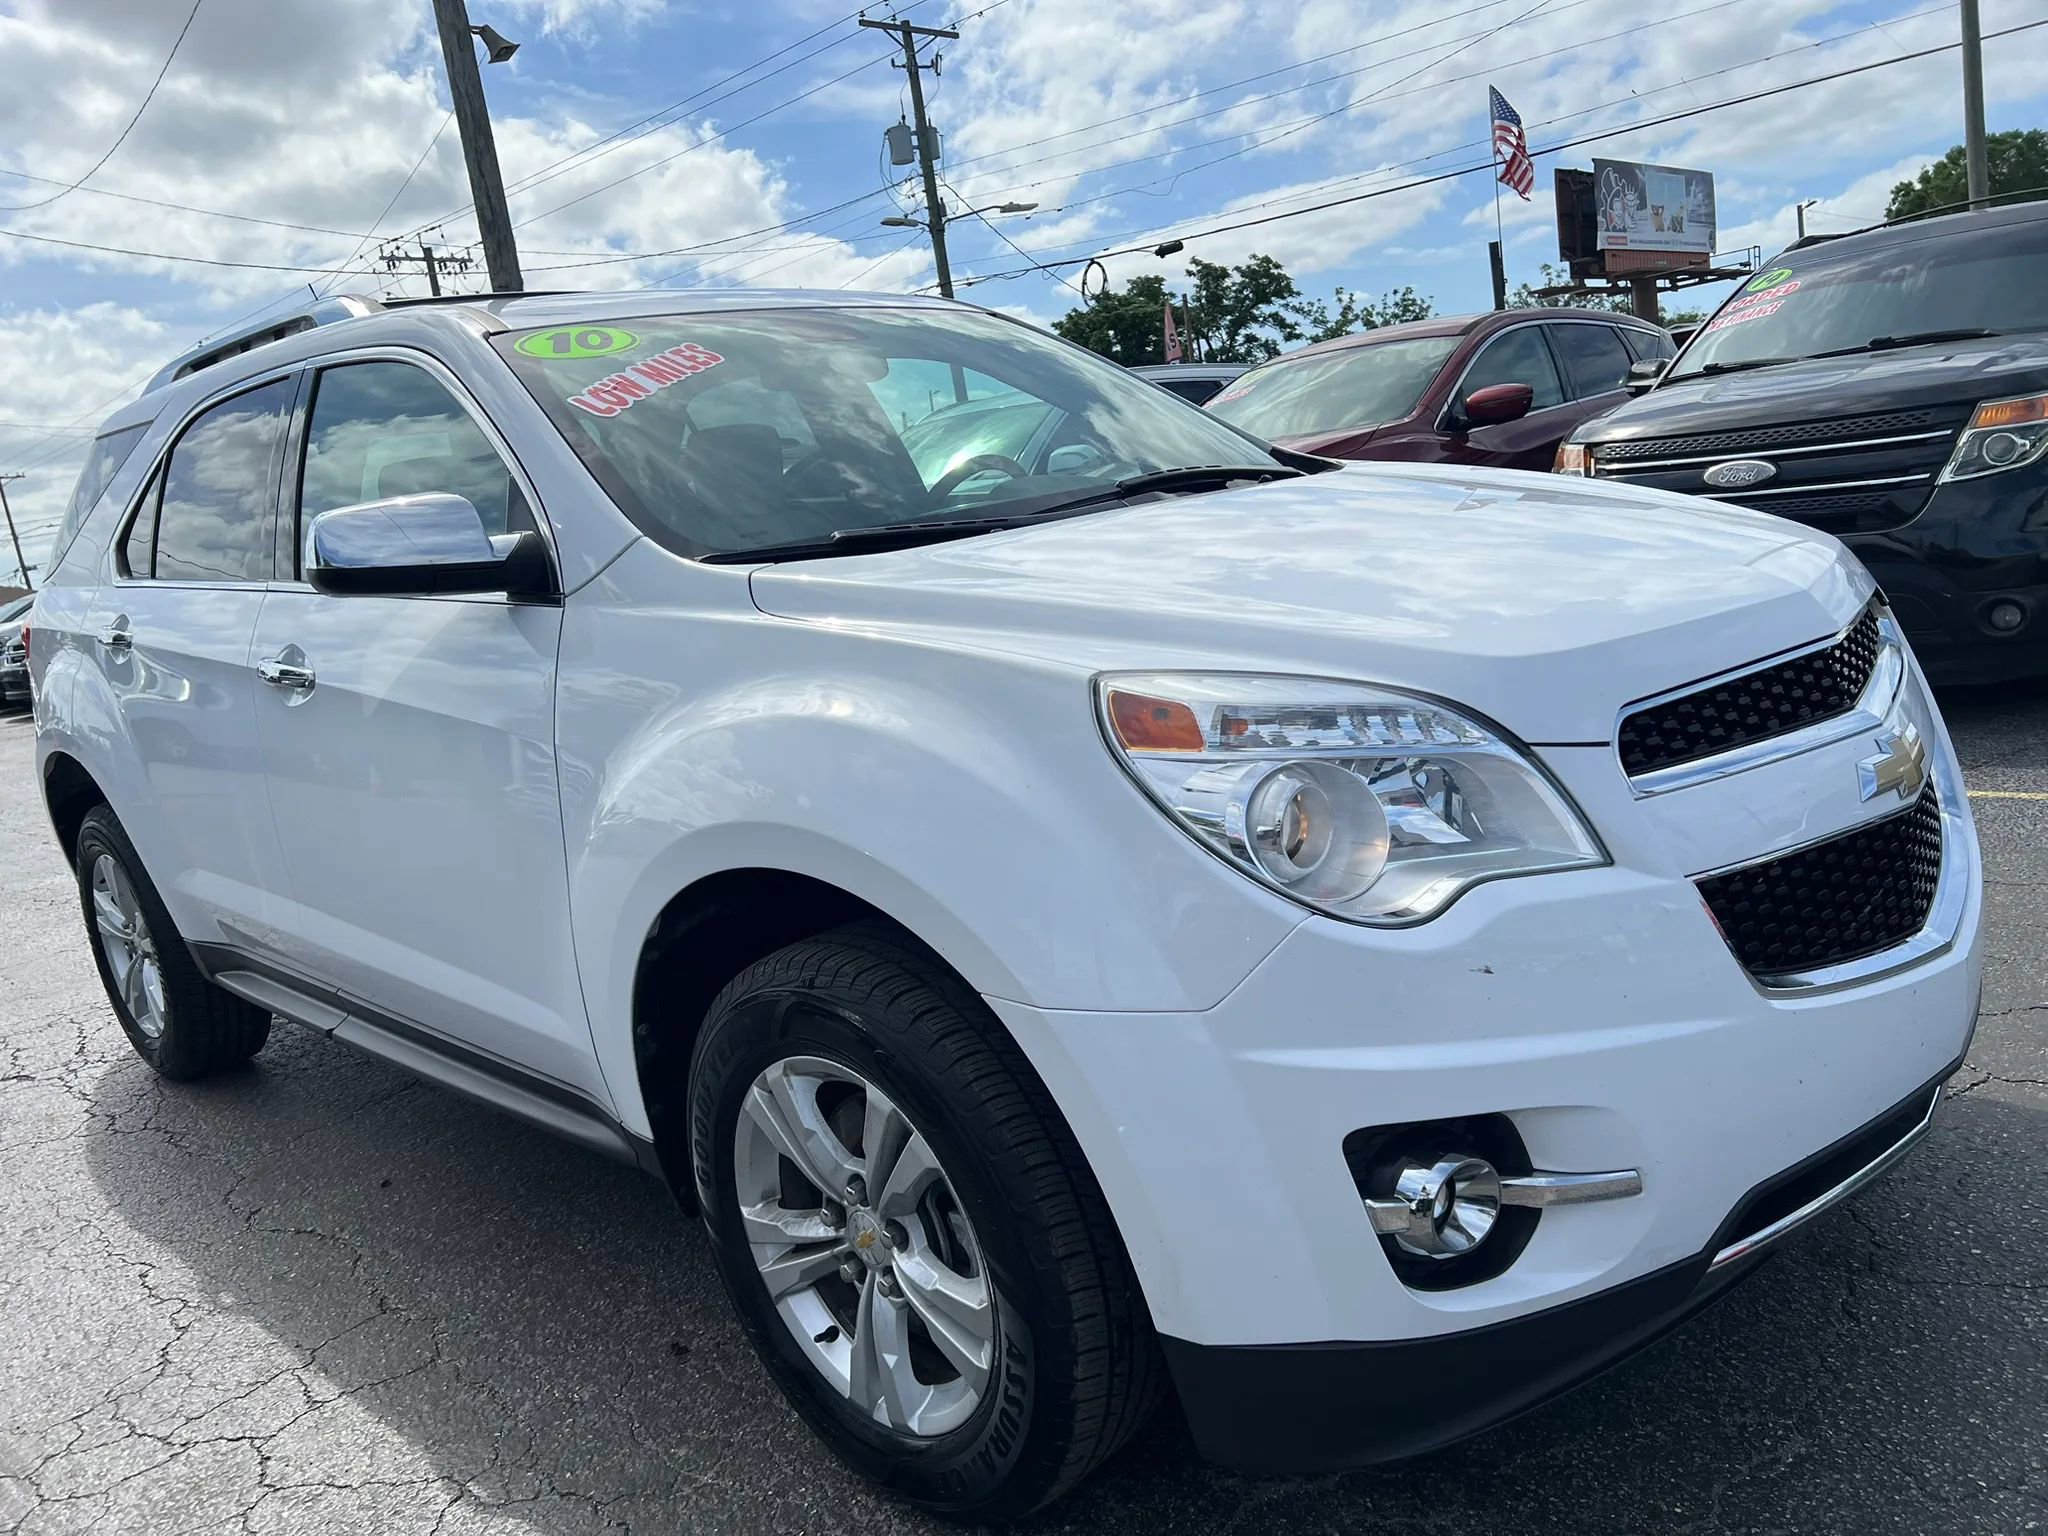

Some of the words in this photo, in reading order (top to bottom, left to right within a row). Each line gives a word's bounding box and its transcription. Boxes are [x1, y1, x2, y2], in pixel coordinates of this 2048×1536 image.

[1720, 281, 1800, 315] LOADED
[1725, 301, 1782, 325] FINANCE
[545, 329, 614, 354] 10
[570, 373, 653, 416] LOW
[631, 343, 723, 386] MILES
[1718, 465, 1758, 482] Ford
